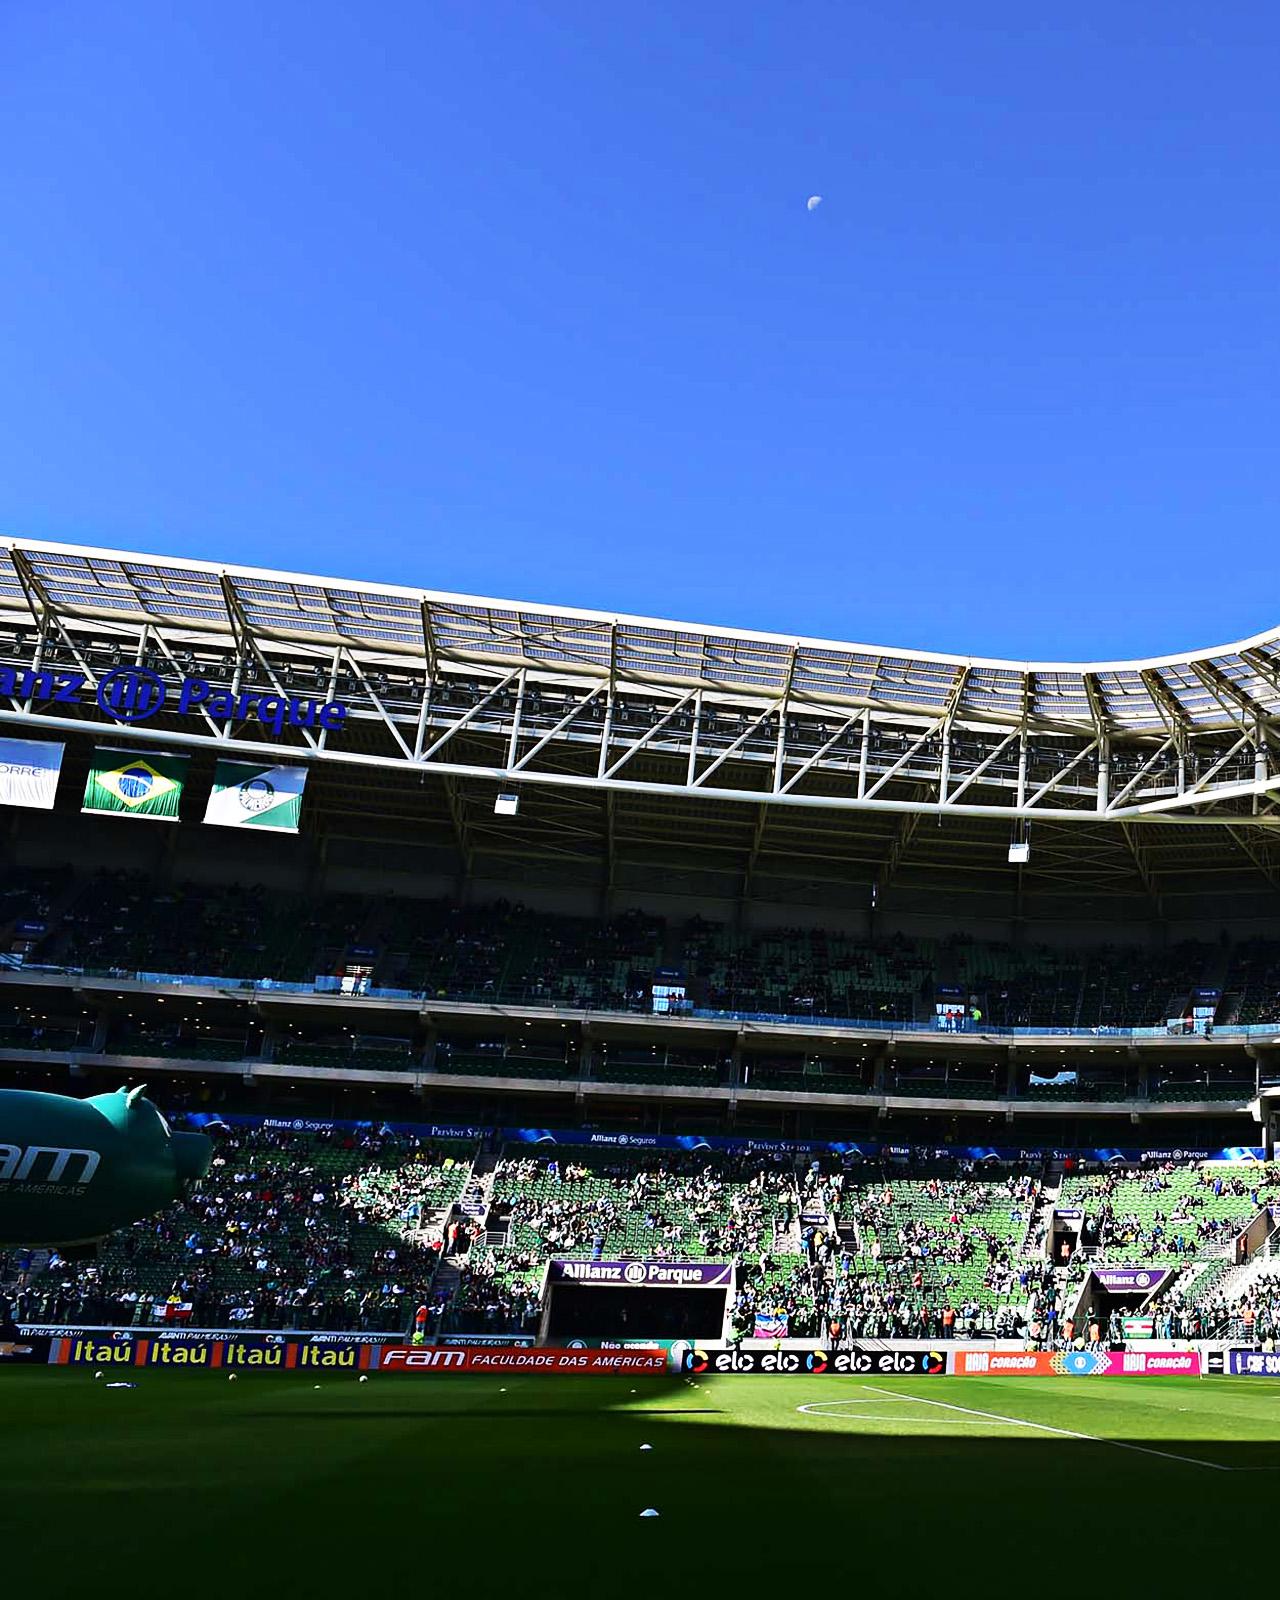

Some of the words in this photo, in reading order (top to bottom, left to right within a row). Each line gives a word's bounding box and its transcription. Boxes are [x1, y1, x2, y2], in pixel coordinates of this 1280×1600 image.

[178, 678, 346, 735] Parque
[263, 1119, 292, 1128] Allianz
[591, 1134, 617, 1143] Allianz
[629, 1136, 656, 1146] Seguros
[1183, 1151, 1208, 1160] Parque
[562, 1263, 621, 1279] Allianz
[649, 1265, 702, 1284] Parque
[1100, 1274, 1135, 1285] Allianz
[74, 1340, 131, 1362] Itaú
[151, 1342, 207, 1364] Itaú
[226, 1343, 282, 1365] Itaú
[301, 1344, 355, 1366] Itaú
[601, 1340, 621, 1350] Não
[471, 1355, 553, 1366] FACULDADE
[558, 1356, 588, 1366] DAS
[714, 1350, 754, 1371] elo
[761, 1351, 800, 1372] elo
[834, 1351, 872, 1372] elo
[878, 1351, 916, 1372] elo
[1246, 1354, 1265, 1372] CBF
